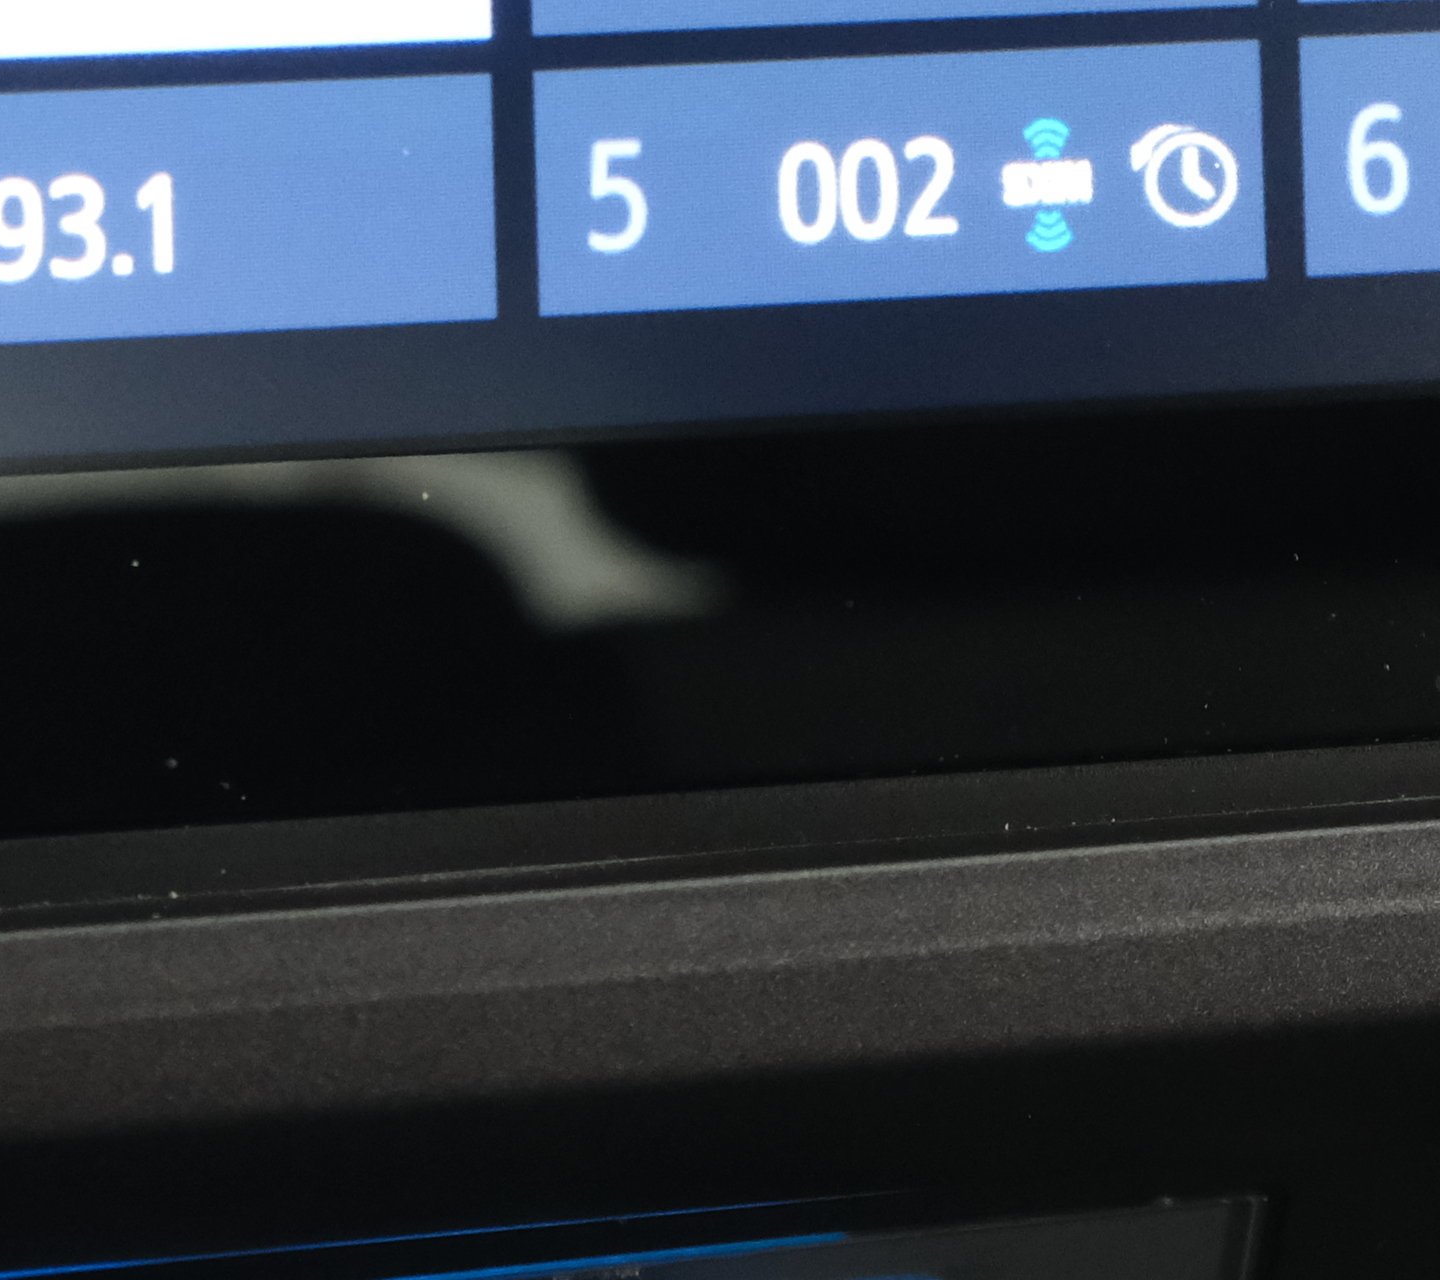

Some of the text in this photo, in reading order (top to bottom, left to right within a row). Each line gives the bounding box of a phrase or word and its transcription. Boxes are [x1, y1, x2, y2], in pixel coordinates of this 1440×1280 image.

[586, 136, 650, 254] 5
[776, 133, 961, 246] 002
[1346, 101, 1411, 215] 6
